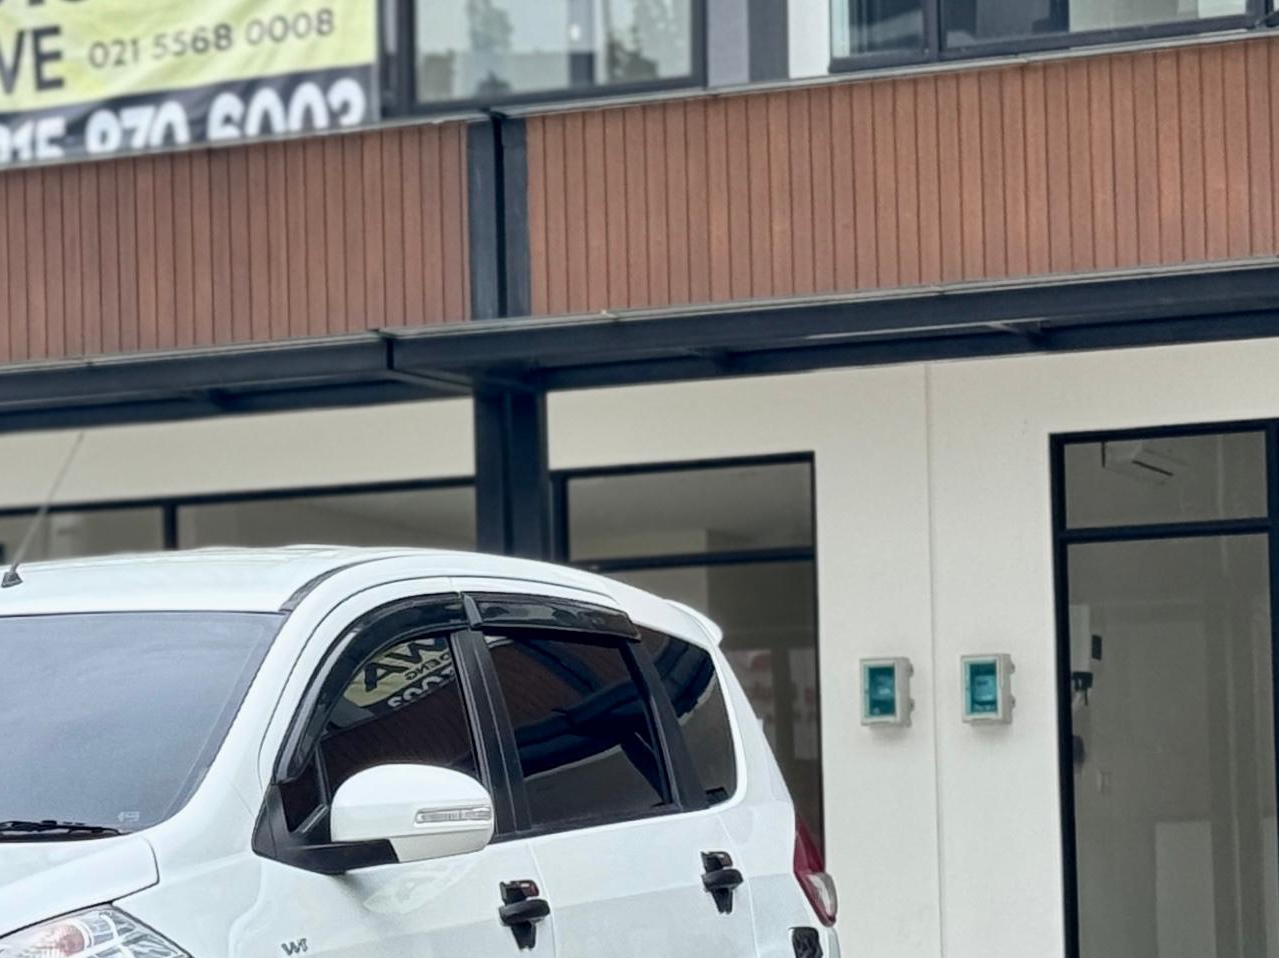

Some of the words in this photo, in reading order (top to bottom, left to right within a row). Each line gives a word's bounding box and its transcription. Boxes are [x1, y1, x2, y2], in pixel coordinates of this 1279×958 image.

[88, 37, 141, 70] 021
[151, 22, 235, 61] 5568
[245, 7, 335, 46] 0008
